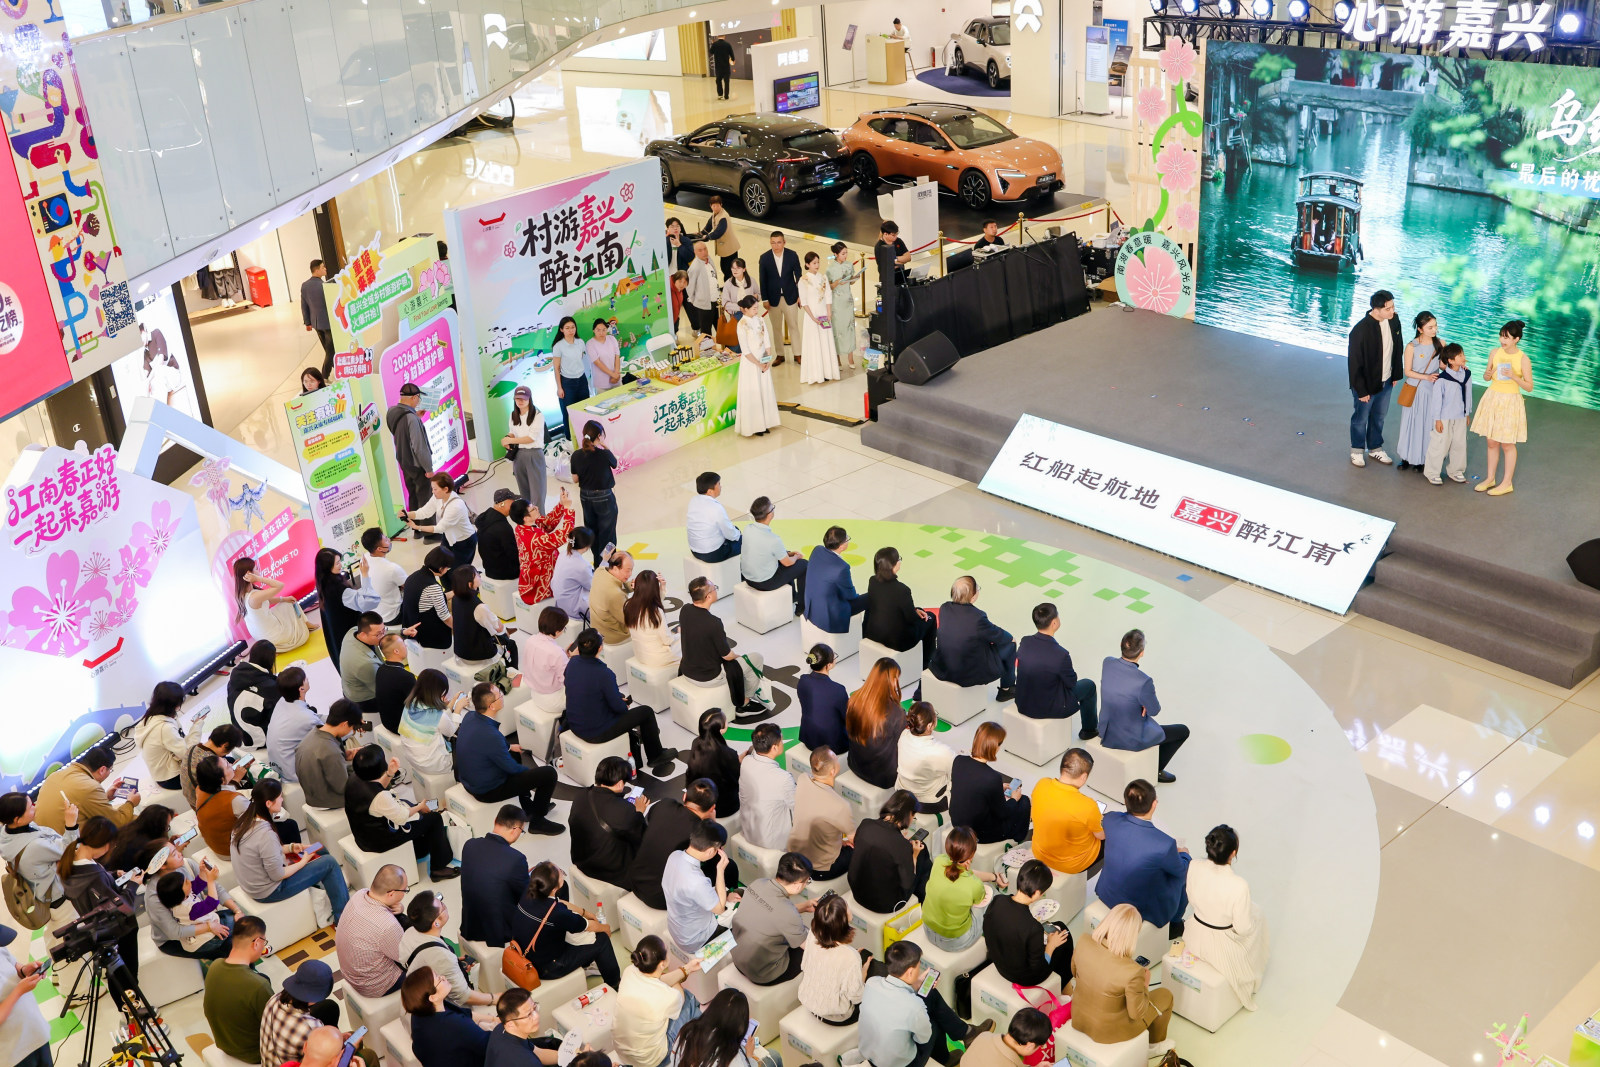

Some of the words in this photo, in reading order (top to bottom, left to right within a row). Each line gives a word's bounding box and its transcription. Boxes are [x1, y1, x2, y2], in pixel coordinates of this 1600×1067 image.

[1342, 0, 1552, 52] 心游嘉兴
[519, 195, 633, 257] 村游嘉兴
[539, 230, 624, 297] 醉江南
[1116, 234, 1153, 276] 南湖春意暖
[1161, 238, 1192, 296] 嘉兴风光好
[295, 403, 336, 429] 关注有礼
[653, 385, 707, 423] 江南春正好
[655, 401, 708, 435] 一起来嘉游
[7, 447, 116, 528] 江南春正好
[1019, 451, 1161, 510] 红船起航地
[13, 475, 121, 548] 一起来嘉游
[289, 548, 299, 559] TO
